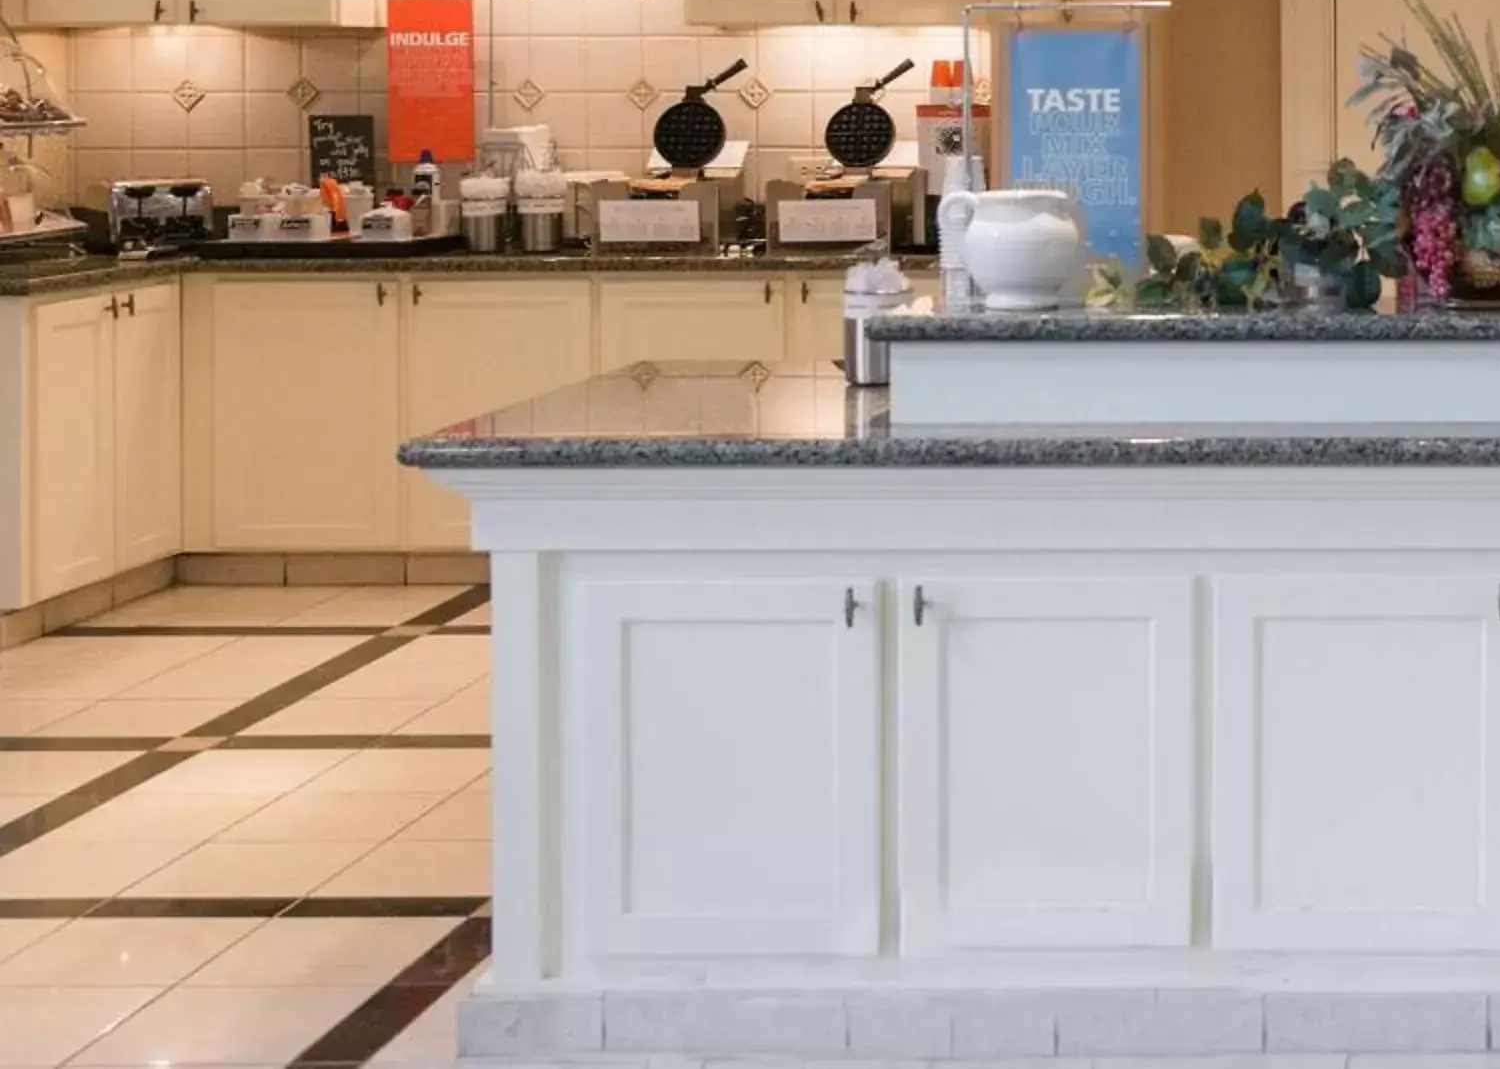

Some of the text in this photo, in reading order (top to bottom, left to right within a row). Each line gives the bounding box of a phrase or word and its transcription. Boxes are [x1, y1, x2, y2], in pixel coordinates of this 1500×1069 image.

[390, 31, 470, 47] INDULGE
[1026, 88, 1121, 112] TASTE
[312, 118, 335, 134] Try
[1041, 132, 1108, 158] MIX
